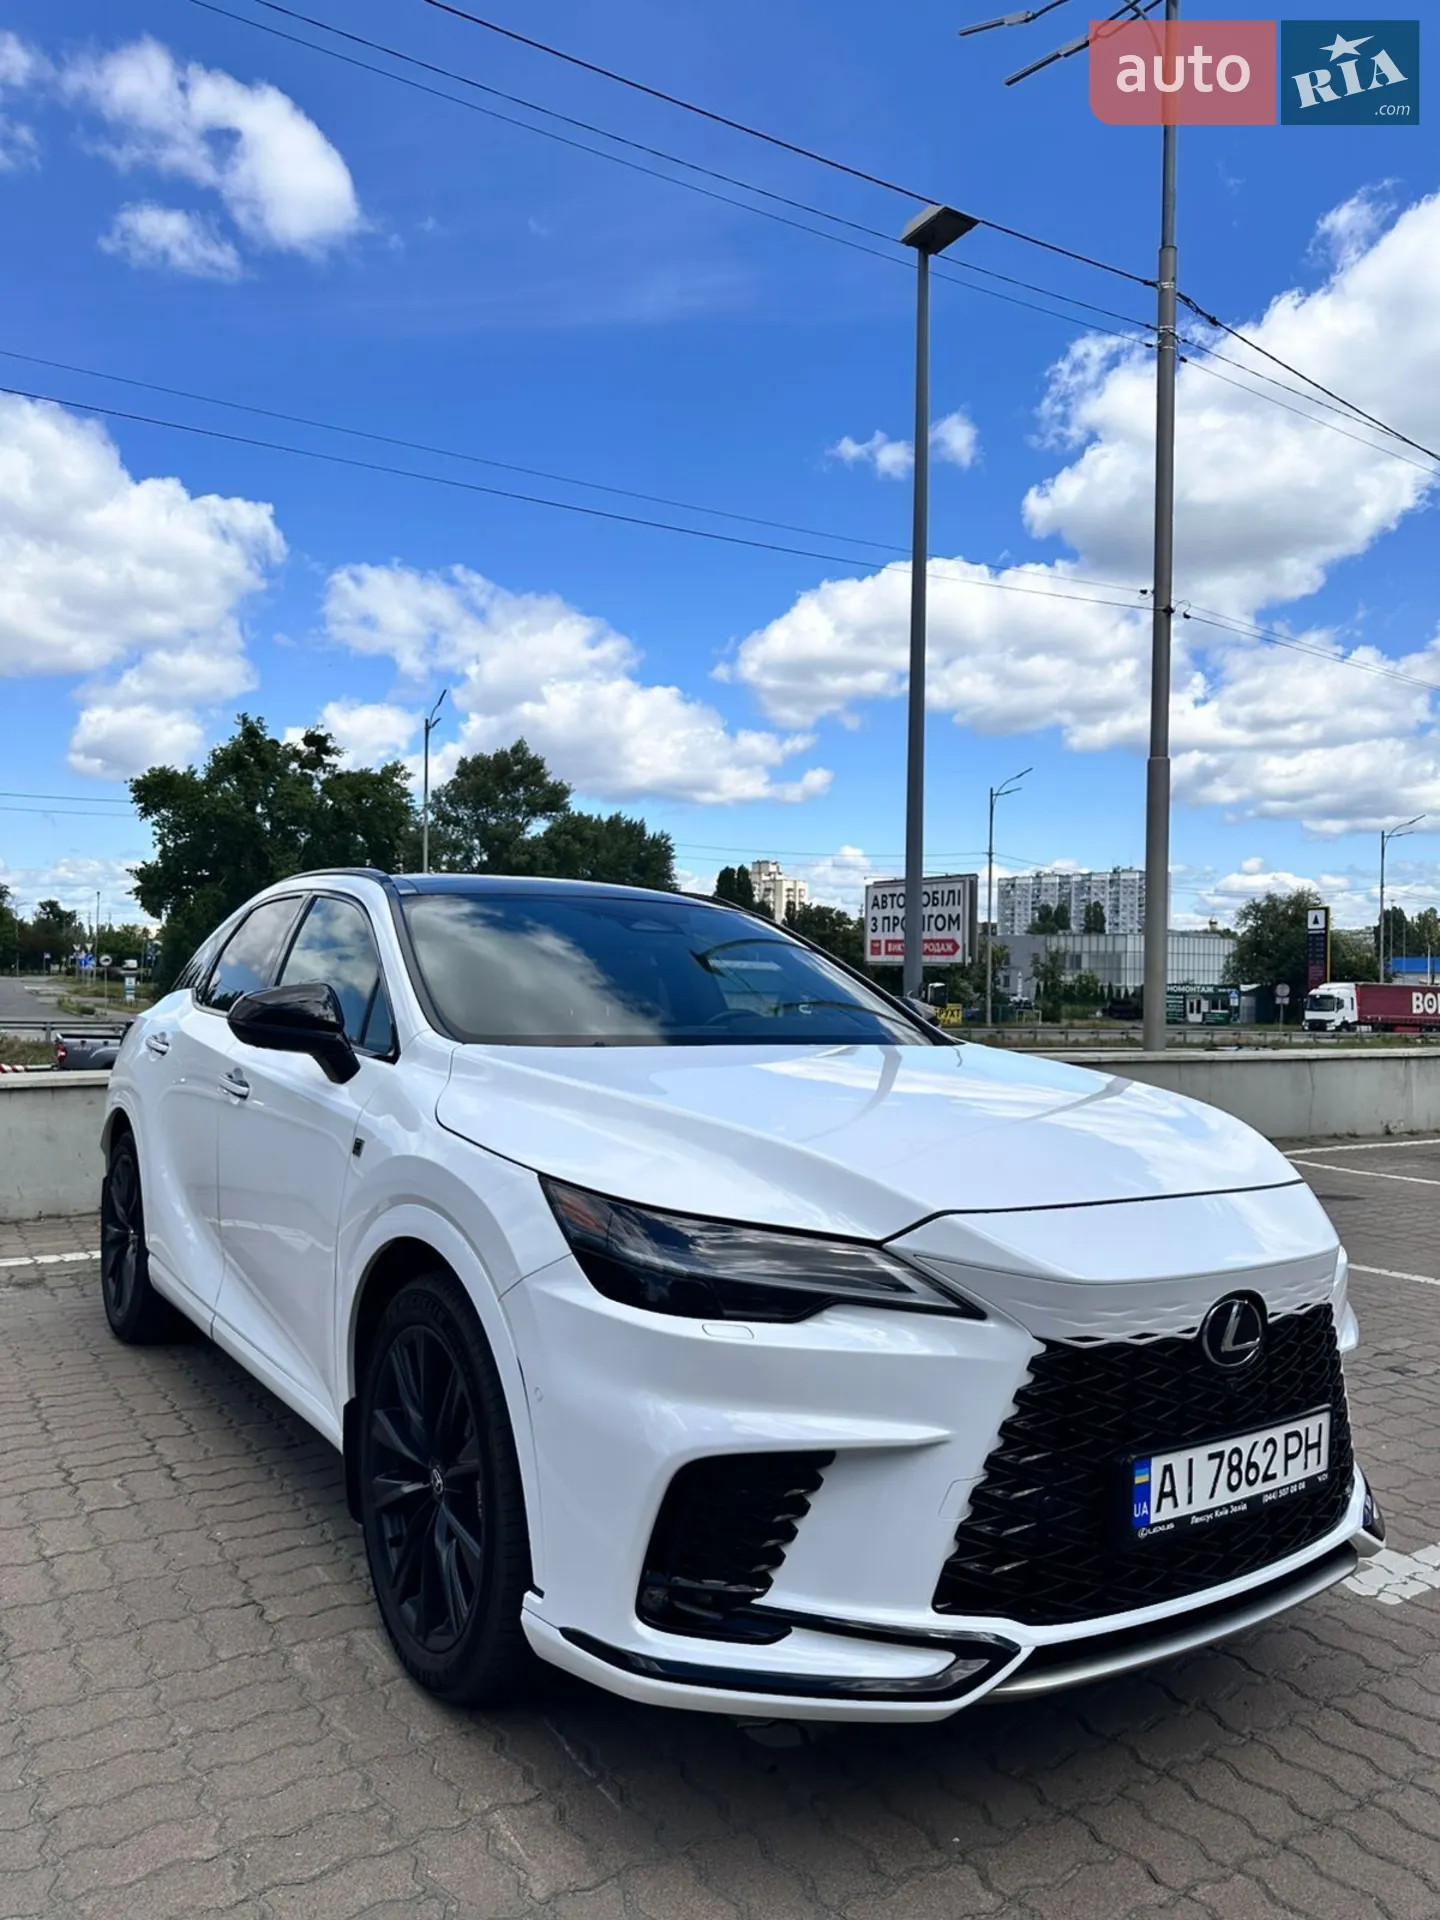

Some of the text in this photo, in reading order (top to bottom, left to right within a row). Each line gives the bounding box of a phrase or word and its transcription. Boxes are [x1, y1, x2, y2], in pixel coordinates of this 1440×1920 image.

[871, 889, 961, 910] АВТООБІЛІ
[882, 913, 961, 933] ПРІГОМ
[923, 942, 954, 953] РОДАЖ
[1167, 985, 1215, 993] НОМОНТАЖ
[1412, 991, 1440, 1015] BO
[1207, 1436, 1278, 1500] 7862
[1284, 1422, 1323, 1477] PH
[1133, 1502, 1149, 1518] UA
